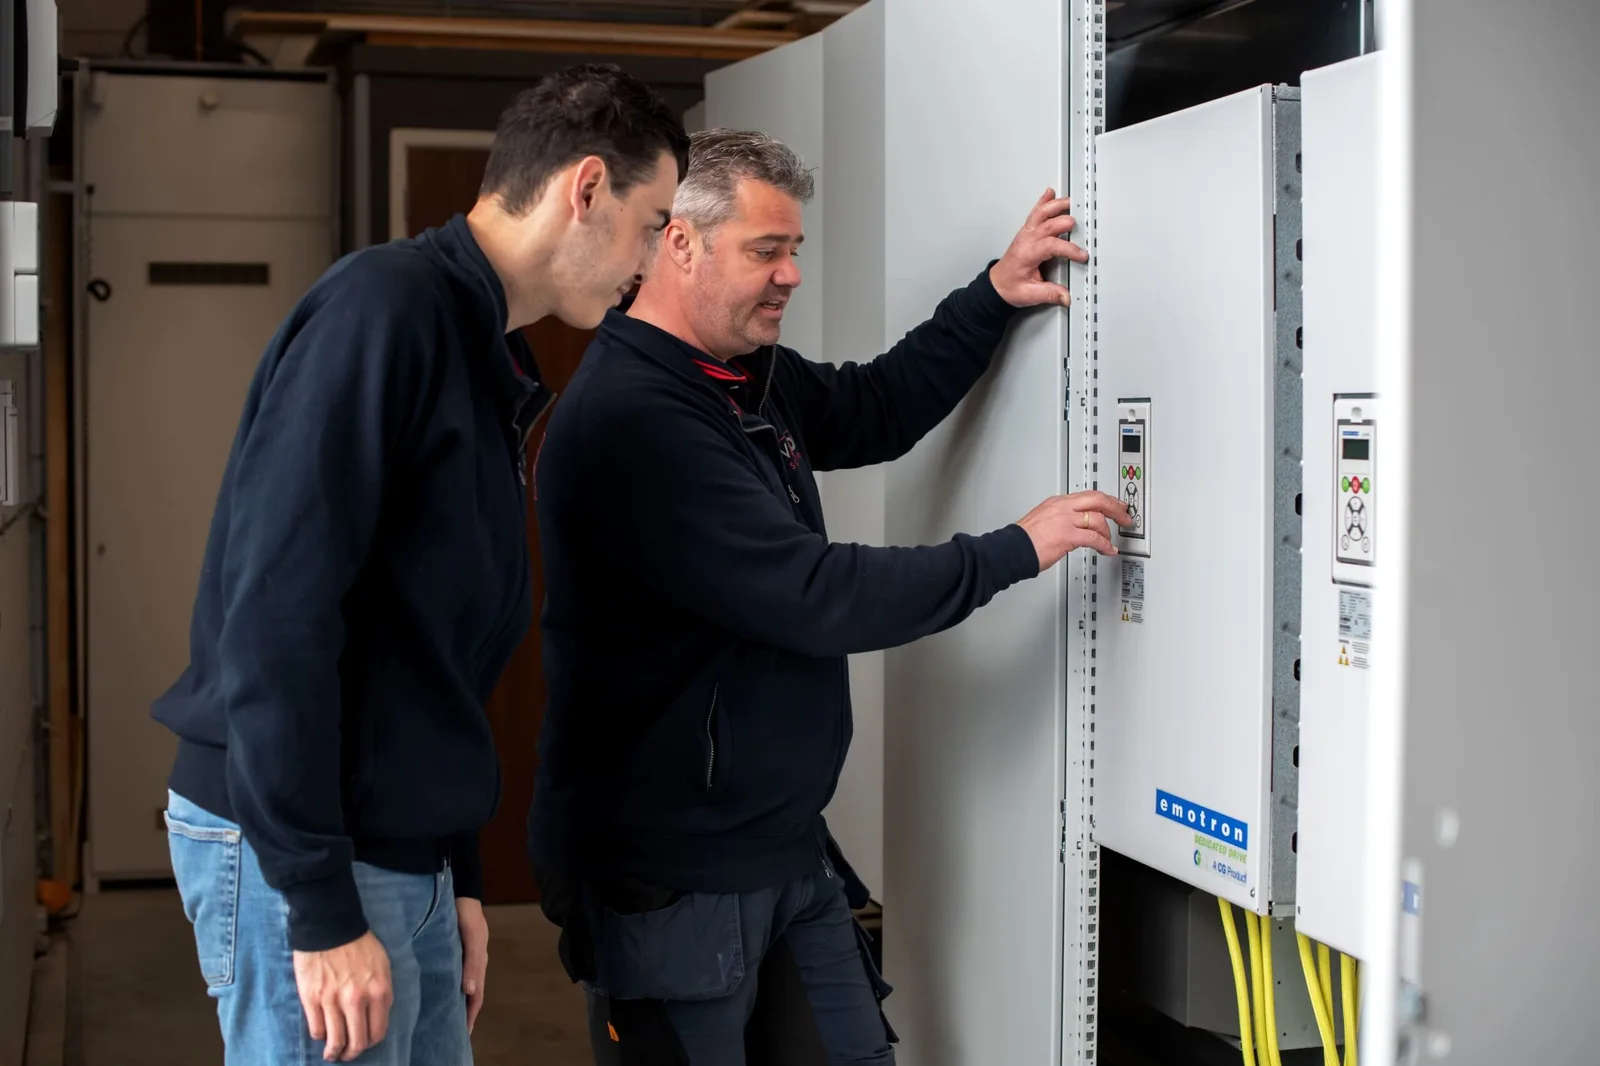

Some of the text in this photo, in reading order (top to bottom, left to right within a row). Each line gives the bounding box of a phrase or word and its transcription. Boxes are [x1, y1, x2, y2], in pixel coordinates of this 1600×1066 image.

[1160, 798, 1243, 842] emotron
[1194, 834, 1247, 864] DEDICATED DRIVE
[1217, 862, 1227, 875] CG
[1227, 866, 1247, 884] Product
